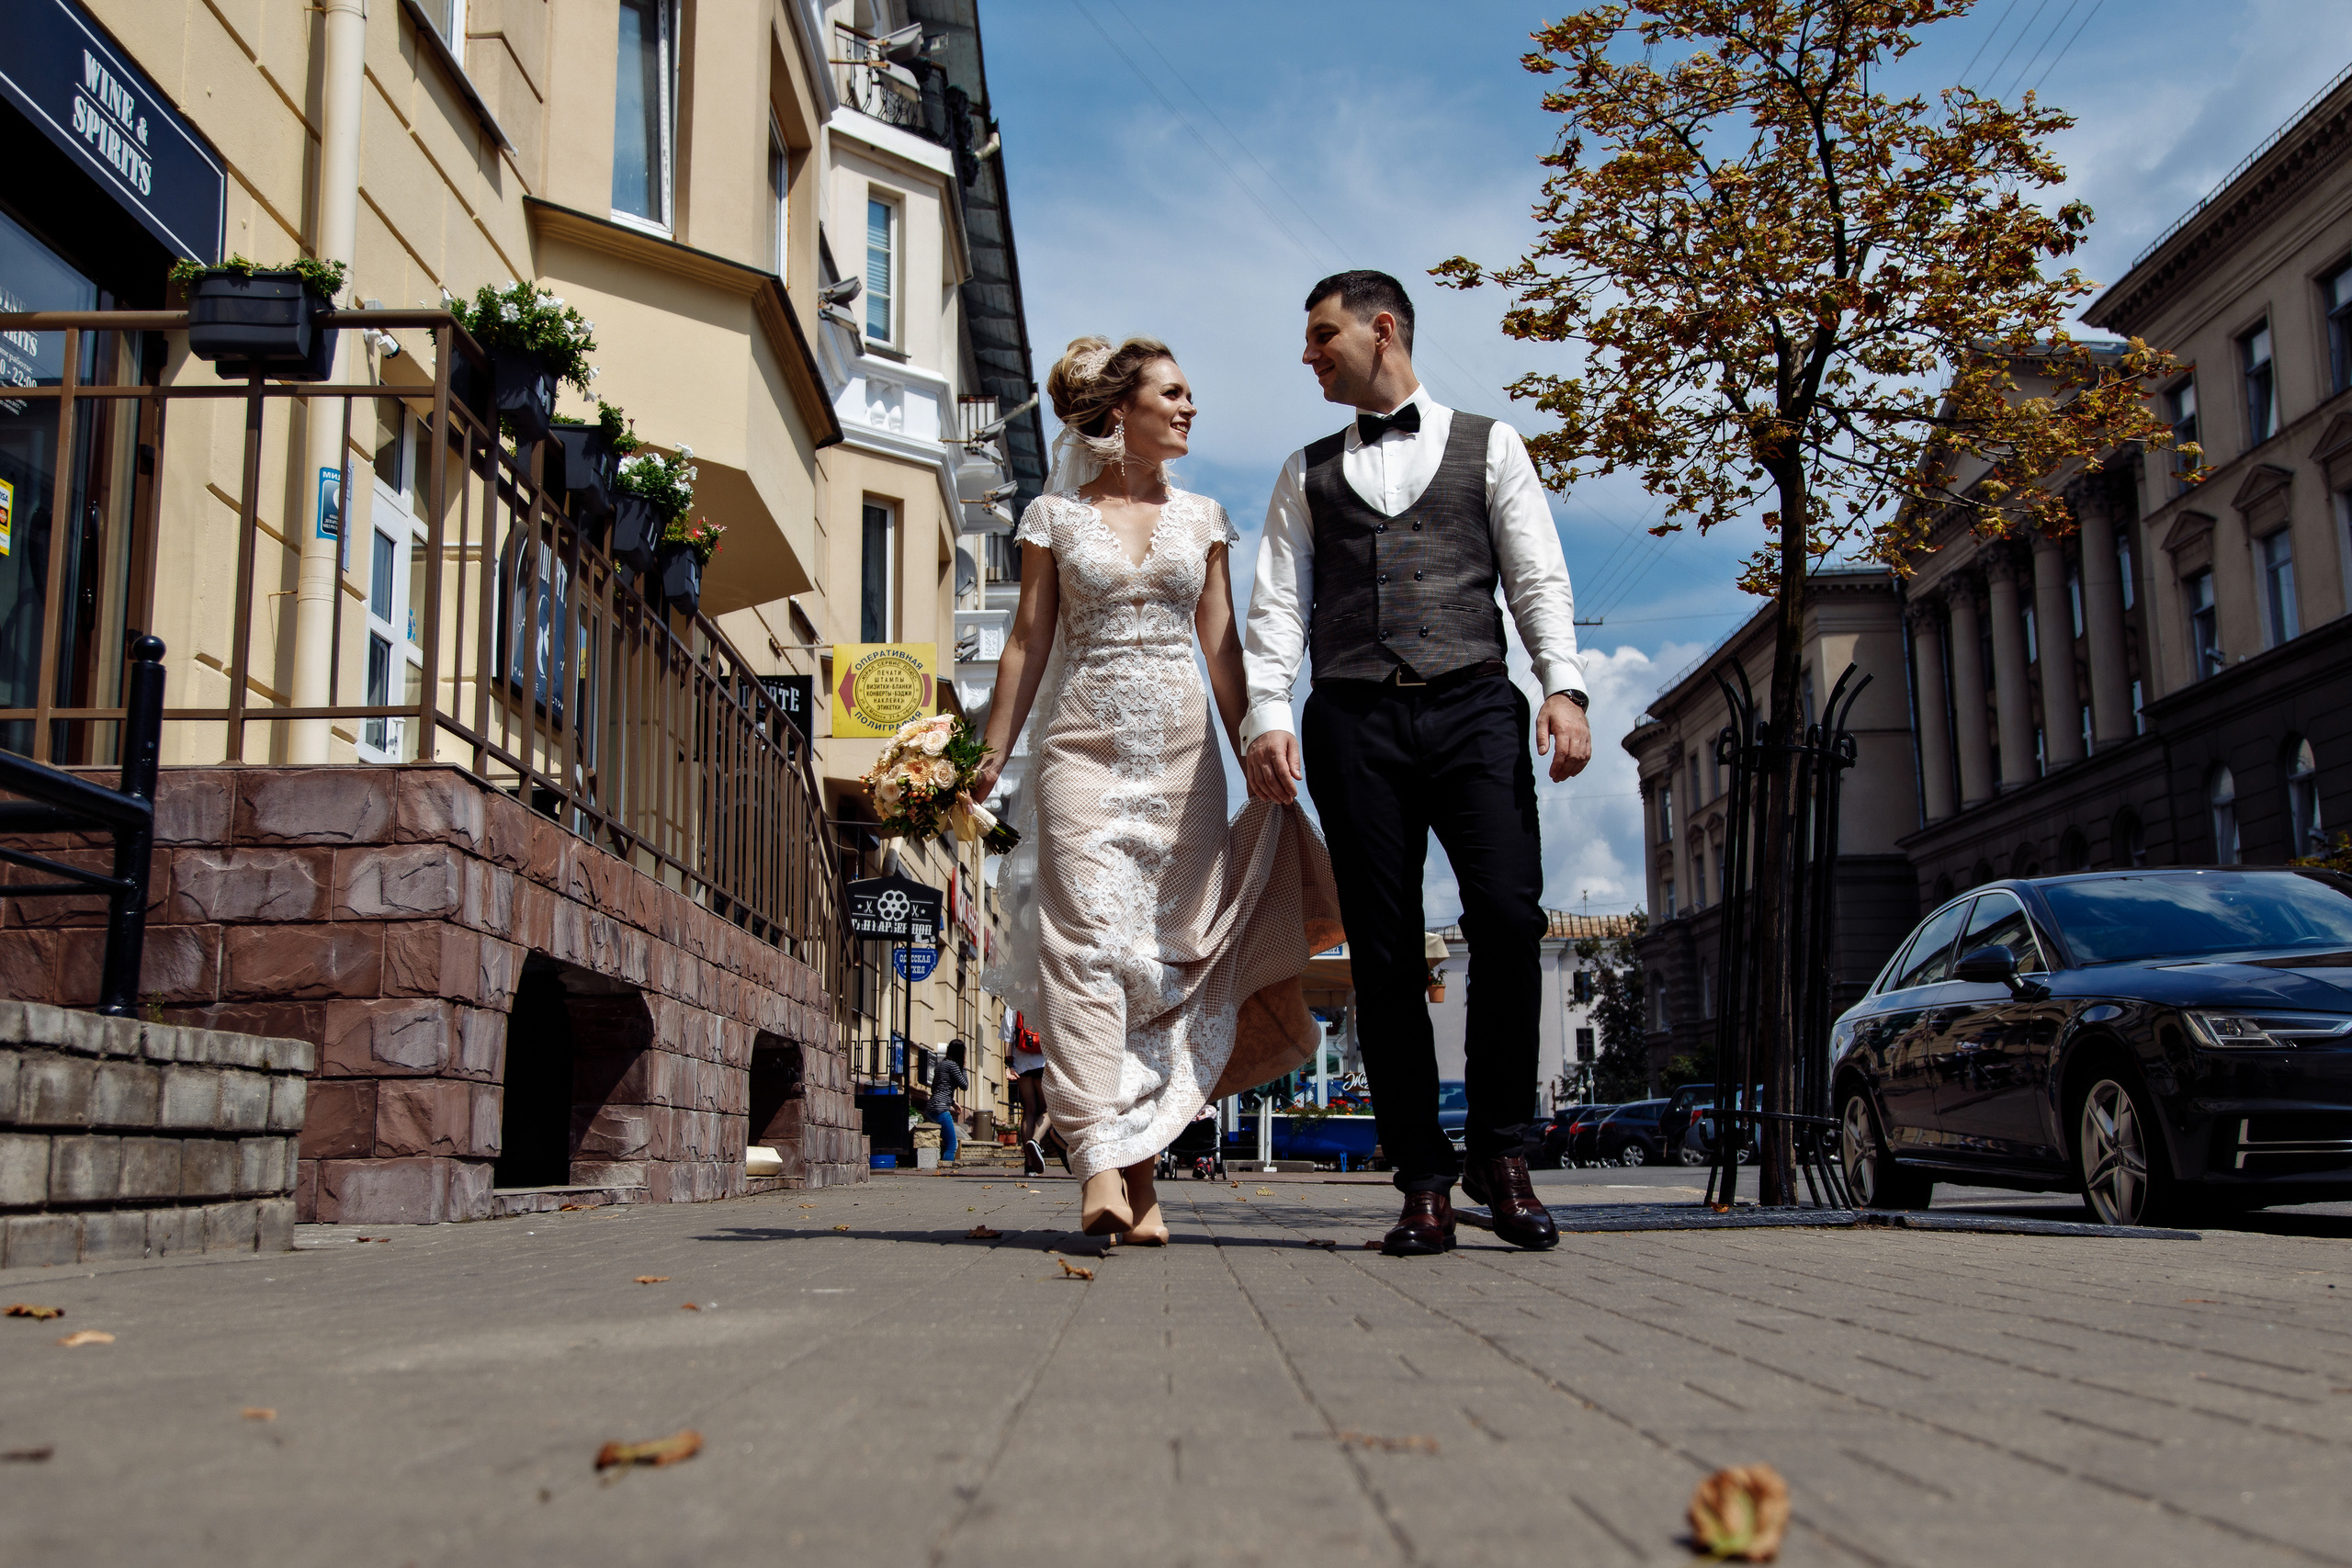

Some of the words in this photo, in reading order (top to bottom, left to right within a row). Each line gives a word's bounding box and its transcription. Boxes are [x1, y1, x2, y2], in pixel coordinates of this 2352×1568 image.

[84, 49, 135, 131] WINE
[137, 117, 149, 147] &
[73, 96, 153, 197] SPIRITS
[854, 649, 923, 670] ОПЕРАТИВНАЯ
[899, 954, 931, 964] ОДССКАЯ
